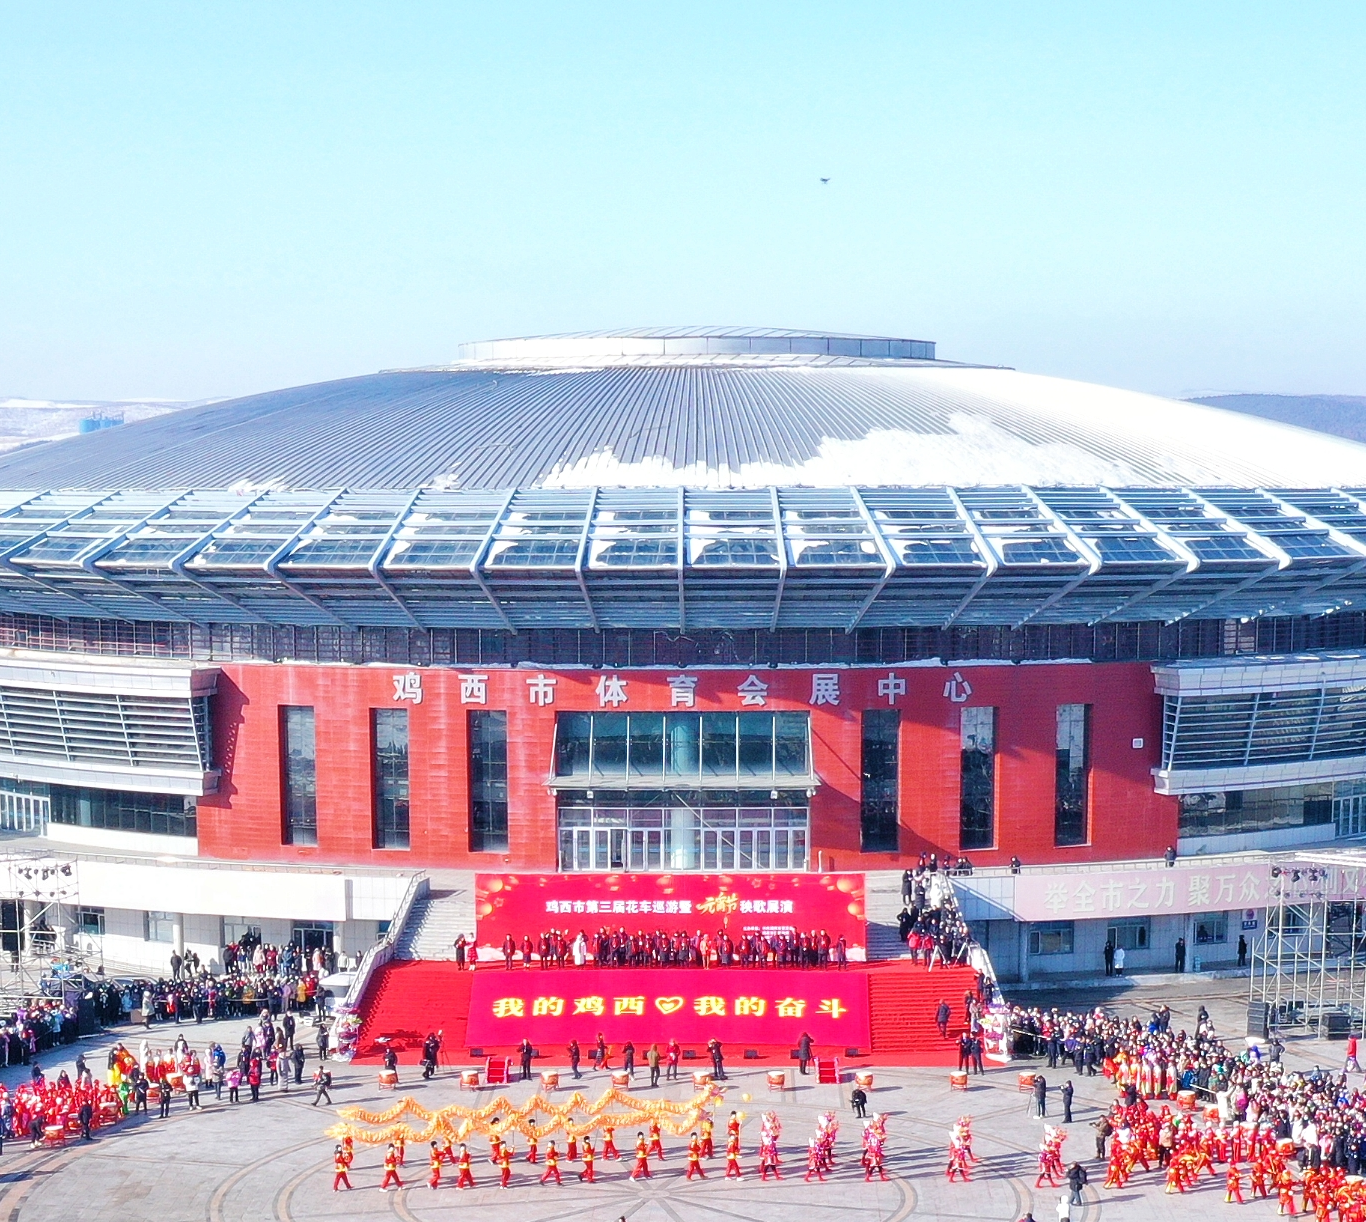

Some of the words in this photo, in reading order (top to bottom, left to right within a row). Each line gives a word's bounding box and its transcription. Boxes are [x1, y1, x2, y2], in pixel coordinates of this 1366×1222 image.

[392, 672, 973, 707] 鸡西市体育会展中心
[545, 899, 692, 914] 鸡西市第三届花车巡游暨
[695, 892, 739, 917] 元宵节
[739, 899, 794, 914] 秧歌展演
[1043, 879, 1176, 914] 举全市之力
[492, 996, 645, 1019] 我的鸡西
[693, 996, 847, 1019] 我的奋斗
